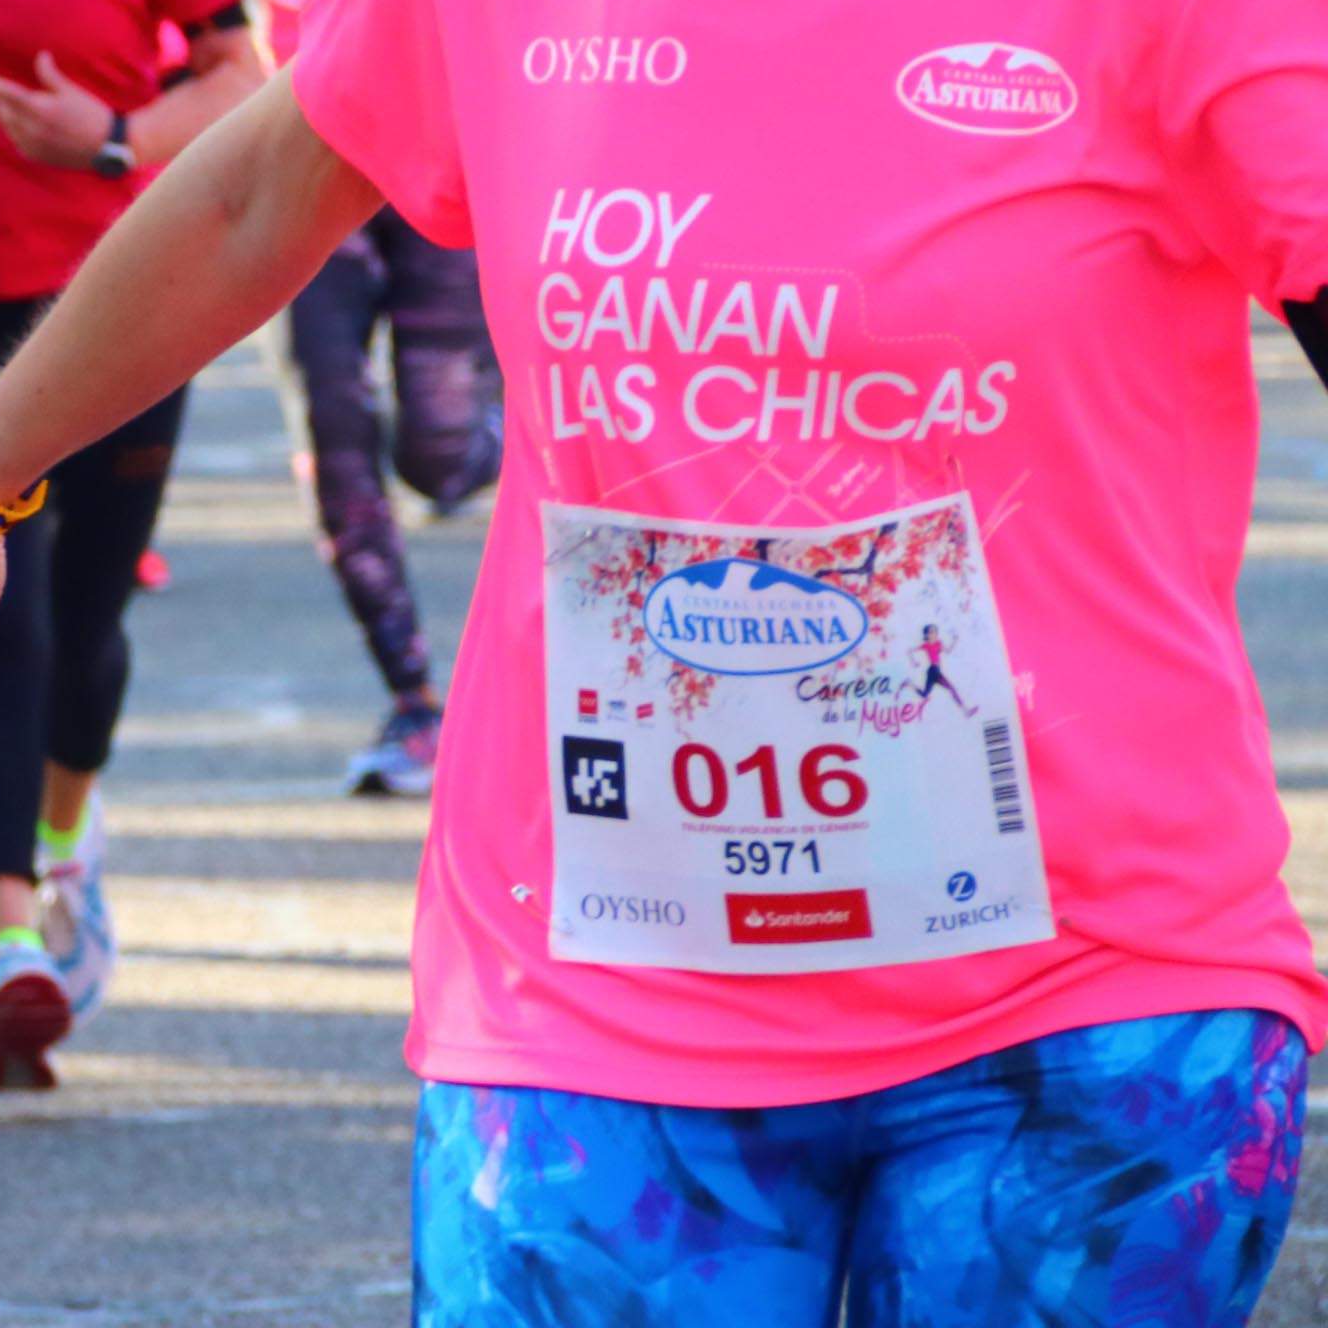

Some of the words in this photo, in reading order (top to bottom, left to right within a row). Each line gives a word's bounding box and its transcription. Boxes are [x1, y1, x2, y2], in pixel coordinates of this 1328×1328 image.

[523, 36, 688, 87] OYSHO
[911, 68, 1065, 114] ASTURIANA
[539, 187, 714, 270] HOY
[536, 272, 839, 359] GANAN
[549, 363, 657, 443] LAS
[682, 360, 1017, 443] CHICAS
[657, 594, 850, 646] ASTURIANA
[797, 673, 894, 703] Carrera
[822, 707, 841, 725] de
[844, 704, 858, 723] la
[858, 697, 930, 738] Mujer
[671, 742, 870, 819] 016
[724, 840, 822, 876] 5971
[580, 892, 686, 928] OYSHO
[766, 908, 851, 928] Santander
[924, 902, 1011, 934] ZURICH
